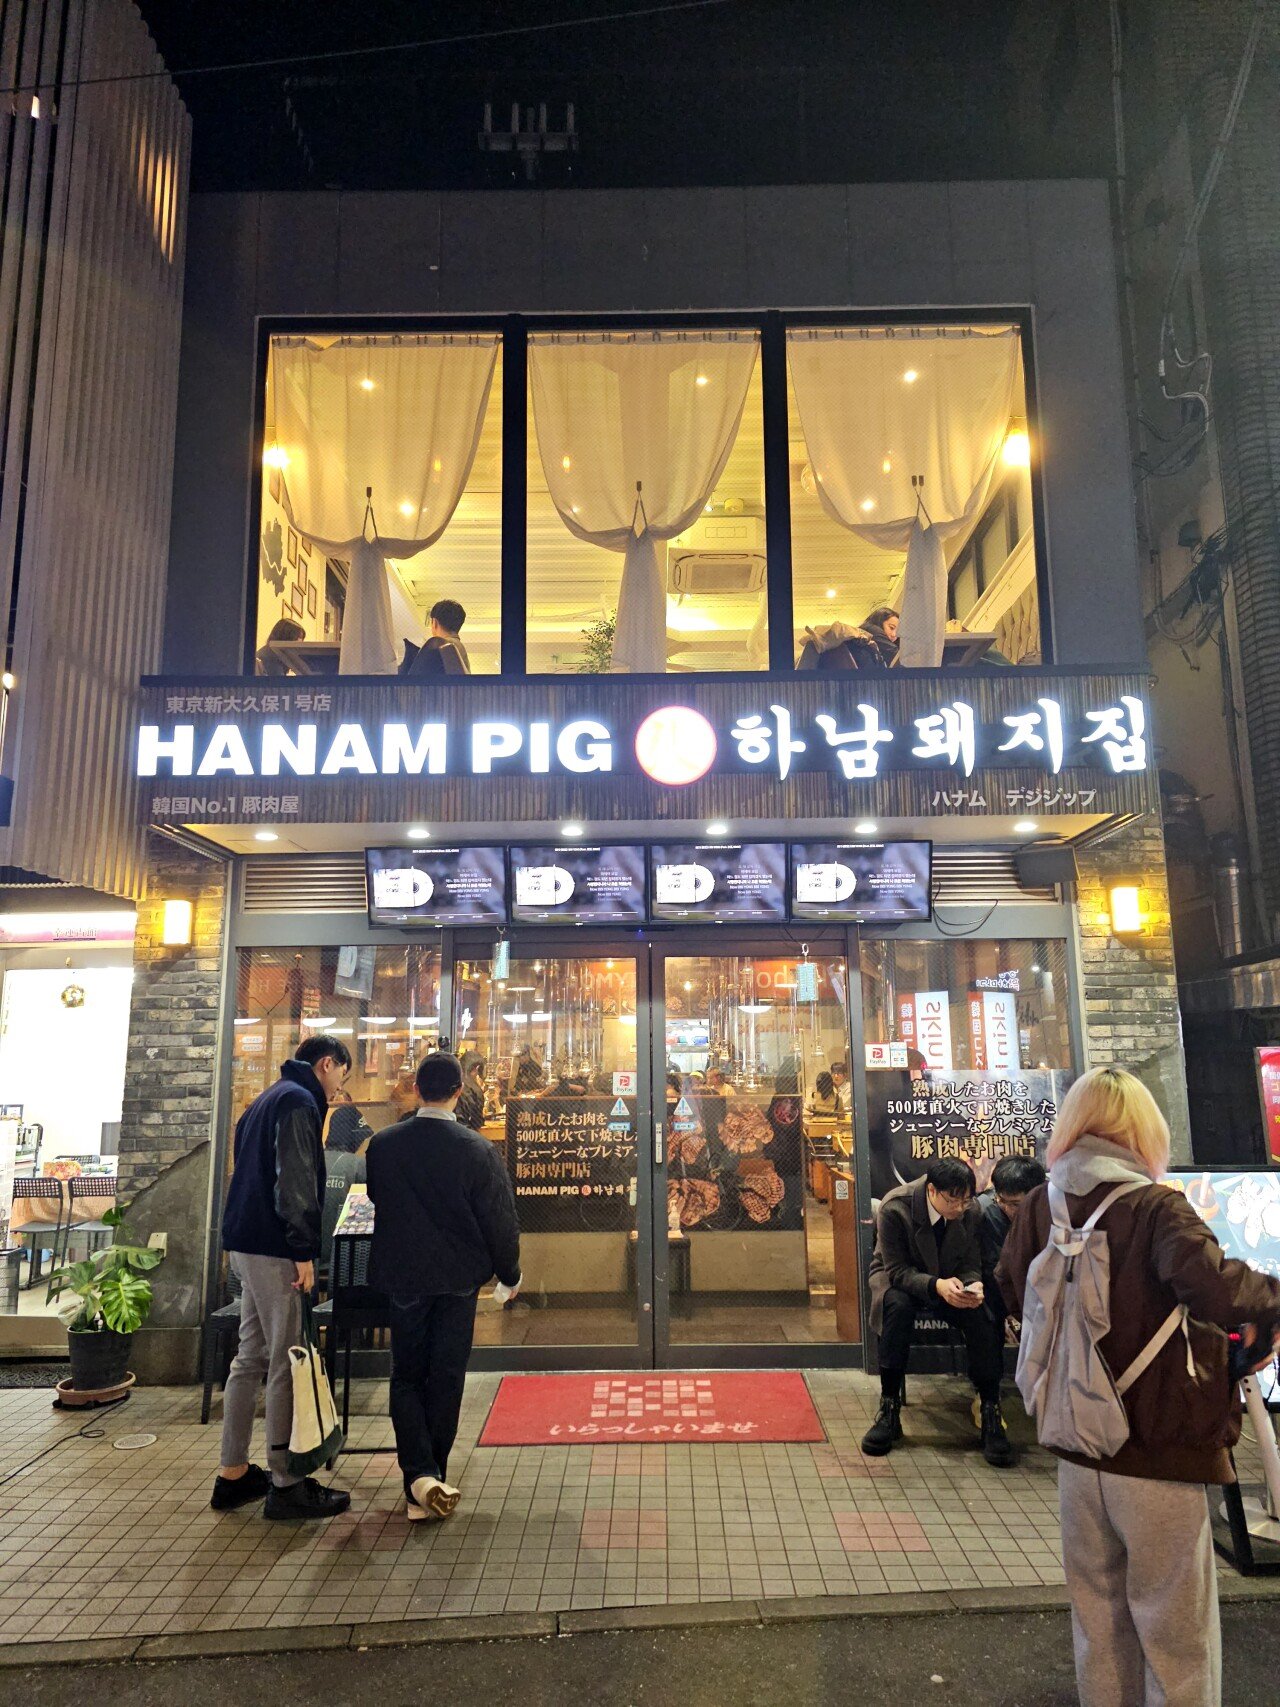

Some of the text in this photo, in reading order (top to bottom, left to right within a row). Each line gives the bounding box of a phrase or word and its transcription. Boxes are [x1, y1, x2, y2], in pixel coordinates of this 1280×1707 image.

[166, 694, 332, 714] 東京新大久保1号店
[730, 695, 1147, 782] 하남돼지집
[137, 722, 447, 777] HANAM
[471, 720, 613, 774] PIG
[932, 786, 1097, 807] ハナム デジジップ
[911, 1079, 1028, 1098] 熟成したお肉を
[887, 1099, 1056, 1115] 500度直火で下焼きした
[516, 1111, 608, 1127] 熟成したお肉を
[889, 1117, 1055, 1133] ジューシーなプレミアム
[516, 1130, 638, 1143] 500度直火で下焼きし
[516, 1144, 638, 1159] ジューシーなプレミア
[911, 1134, 1037, 1160] 豚肉専門店
[516, 1162, 592, 1179] 豚肉専門店
[516, 1186, 558, 1196] HANAM
[559, 1186, 580, 1196] PIG
[914, 1319, 954, 1330] HANA
[549, 1421, 760, 1437] いらっしゃいませ
